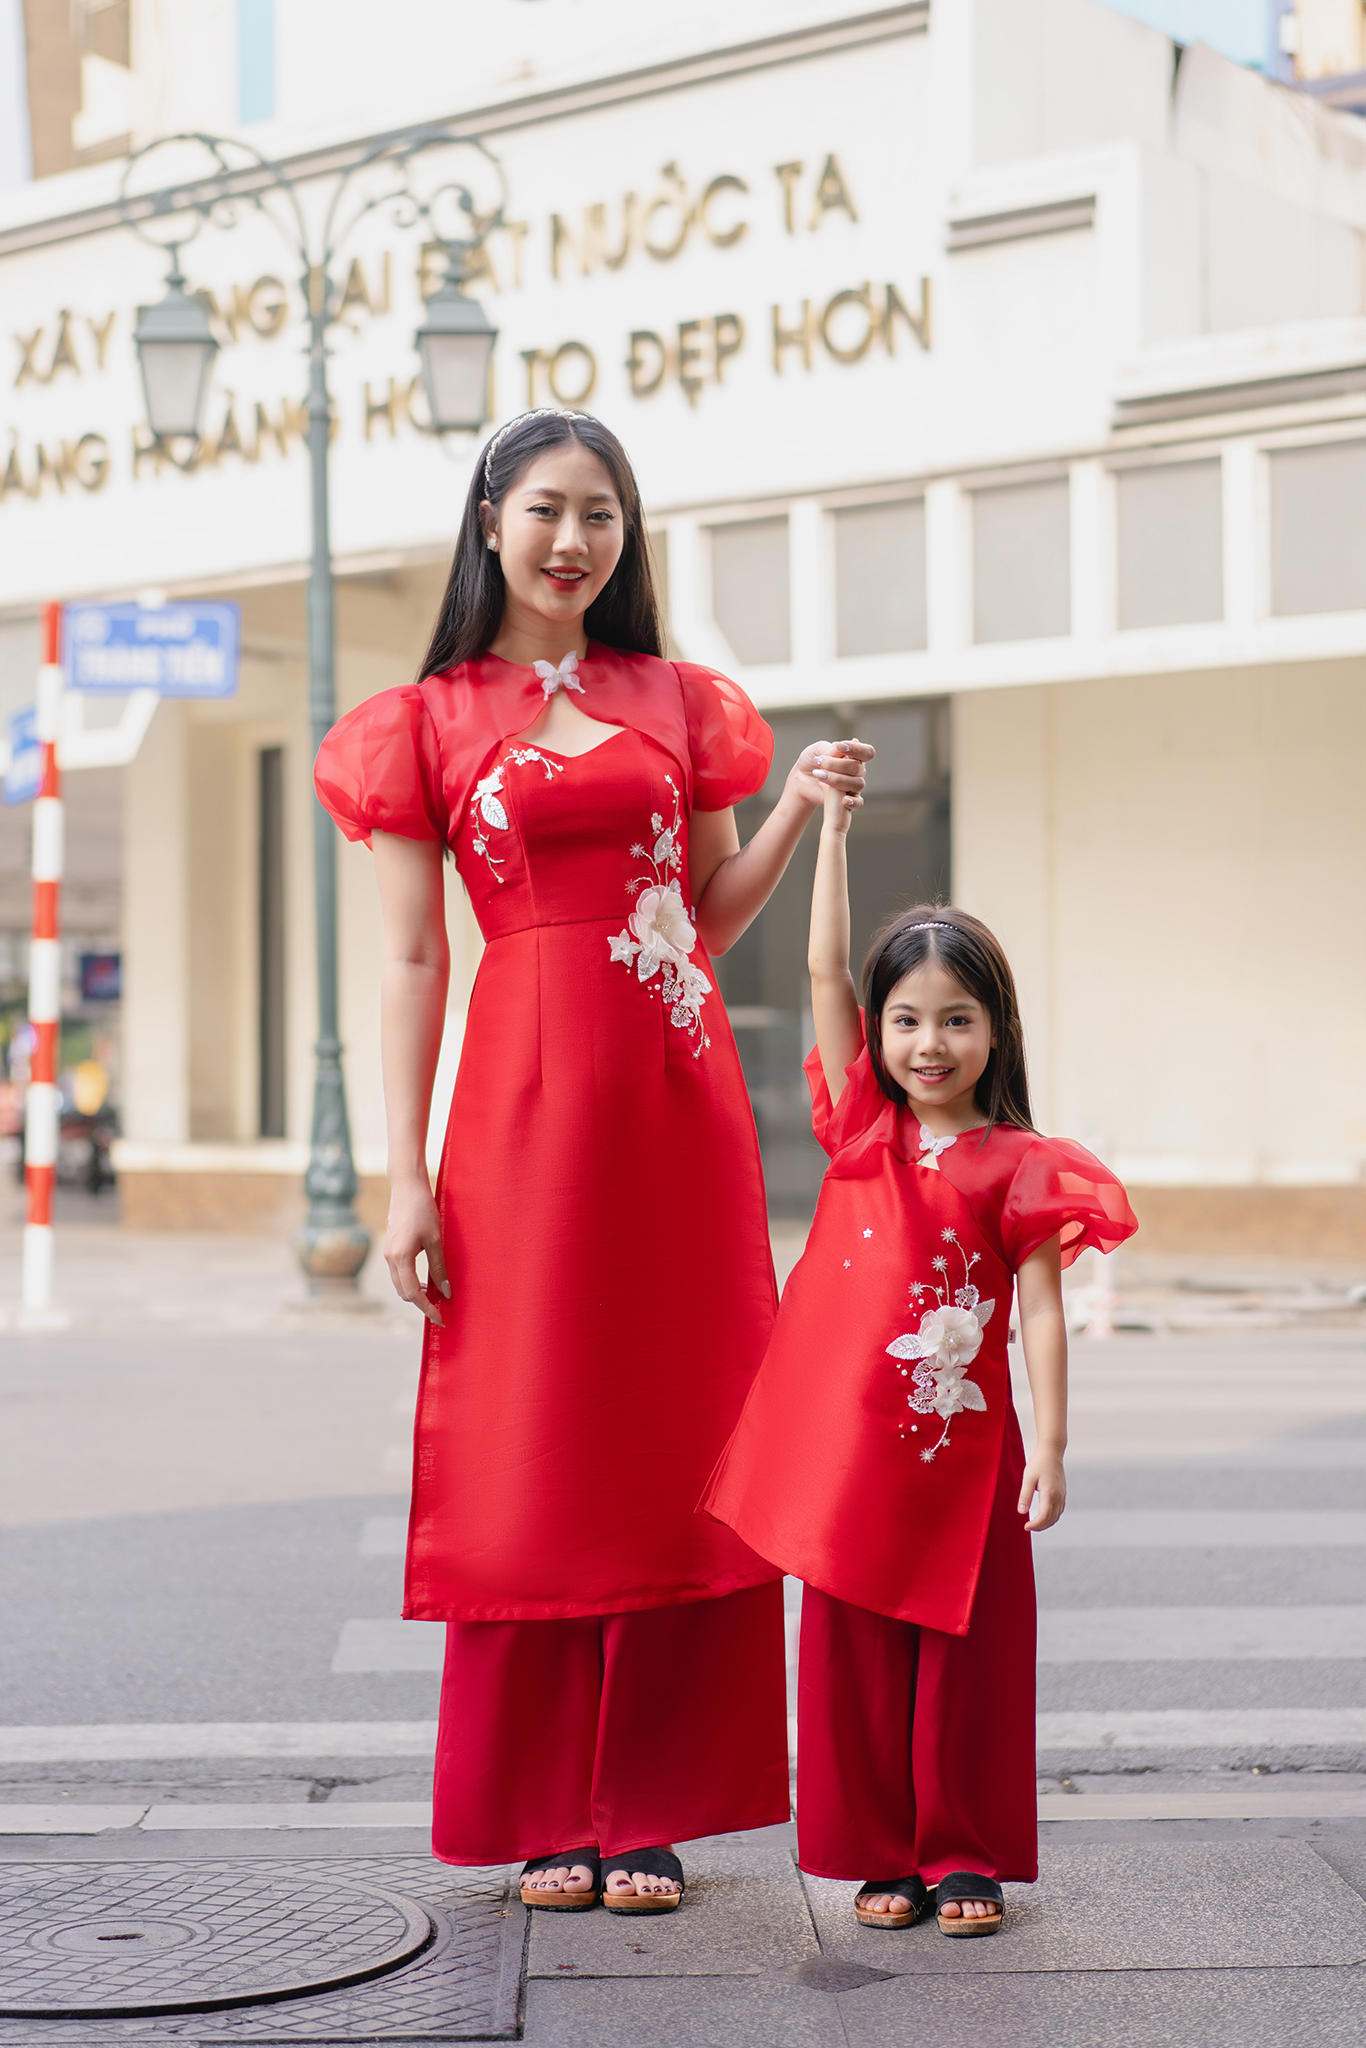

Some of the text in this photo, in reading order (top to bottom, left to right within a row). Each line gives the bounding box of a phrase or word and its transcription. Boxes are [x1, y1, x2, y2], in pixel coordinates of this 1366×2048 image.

[14, 308, 116, 388] XÂY
[312, 250, 391, 335] ẠI
[773, 153, 858, 234] TA
[520, 340, 598, 408] TO
[625, 312, 745, 412] ĐẸP
[771, 276, 932, 376] HƠN
